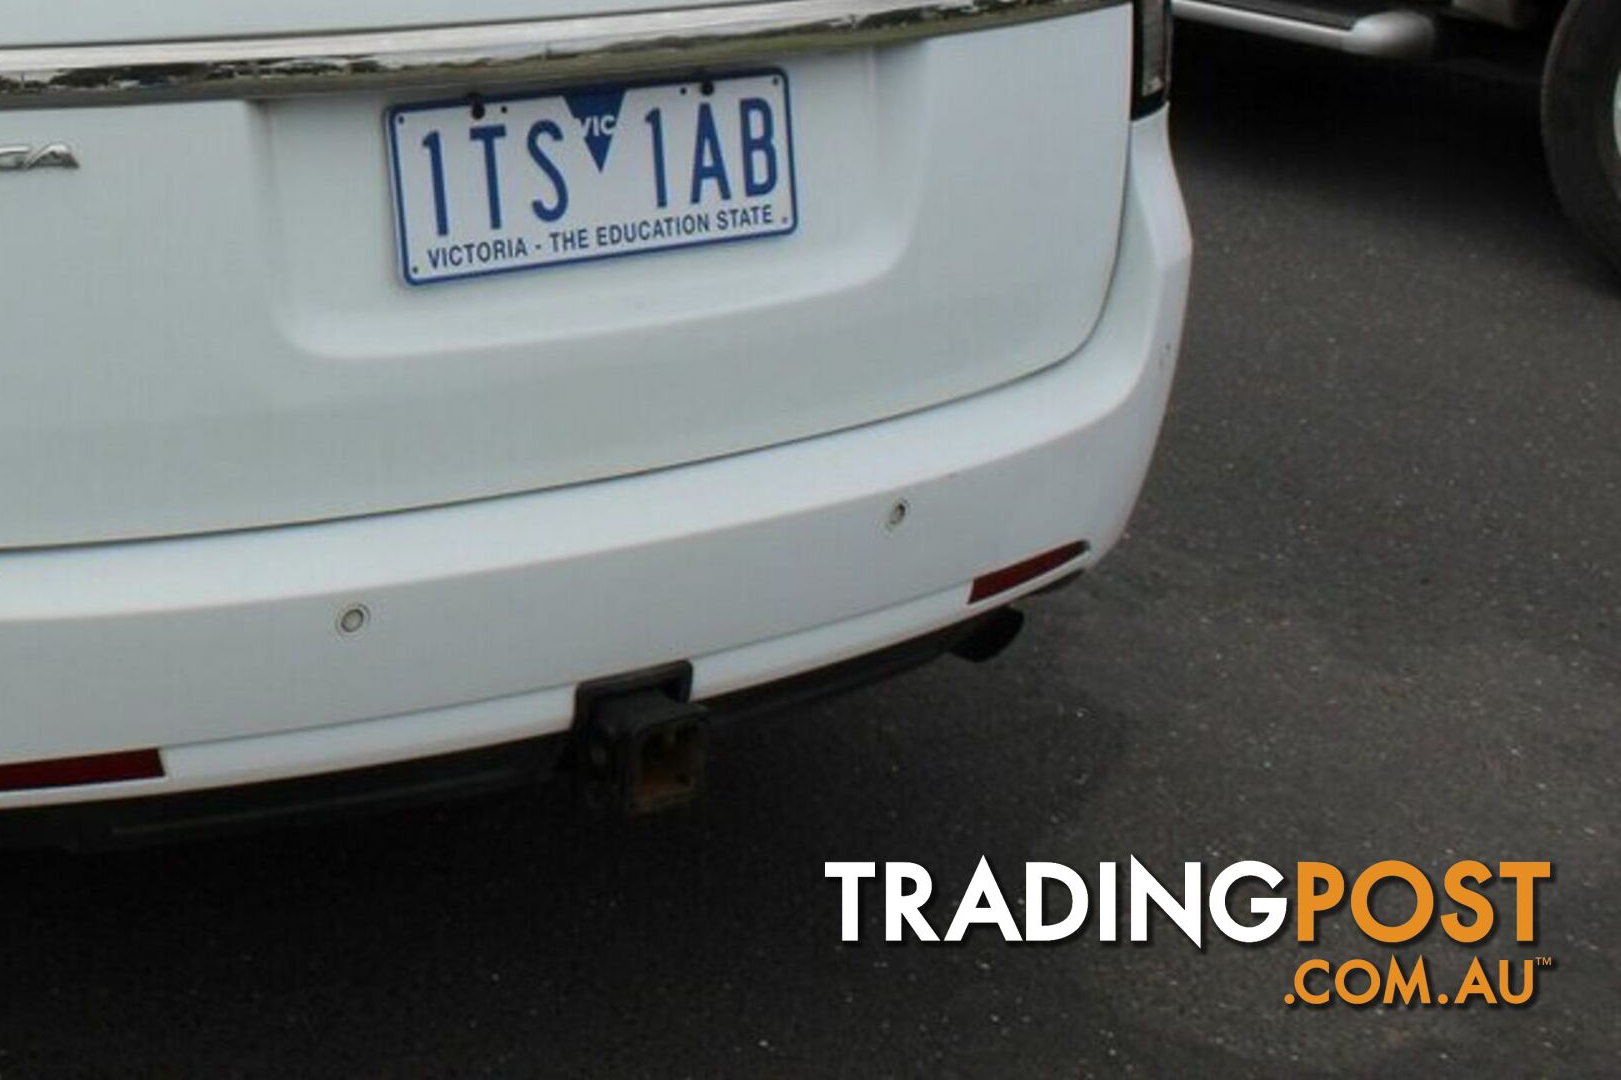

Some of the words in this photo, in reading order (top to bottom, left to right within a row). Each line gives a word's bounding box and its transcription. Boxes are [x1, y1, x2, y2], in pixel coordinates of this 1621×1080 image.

[580, 114, 617, 136] VIC
[423, 119, 569, 236] 1TS
[644, 97, 778, 208] 1AB
[427, 237, 529, 270] VICTORIA
[549, 229, 589, 252] THE
[596, 216, 710, 247] EDUCATION
[716, 204, 774, 229] STATE
